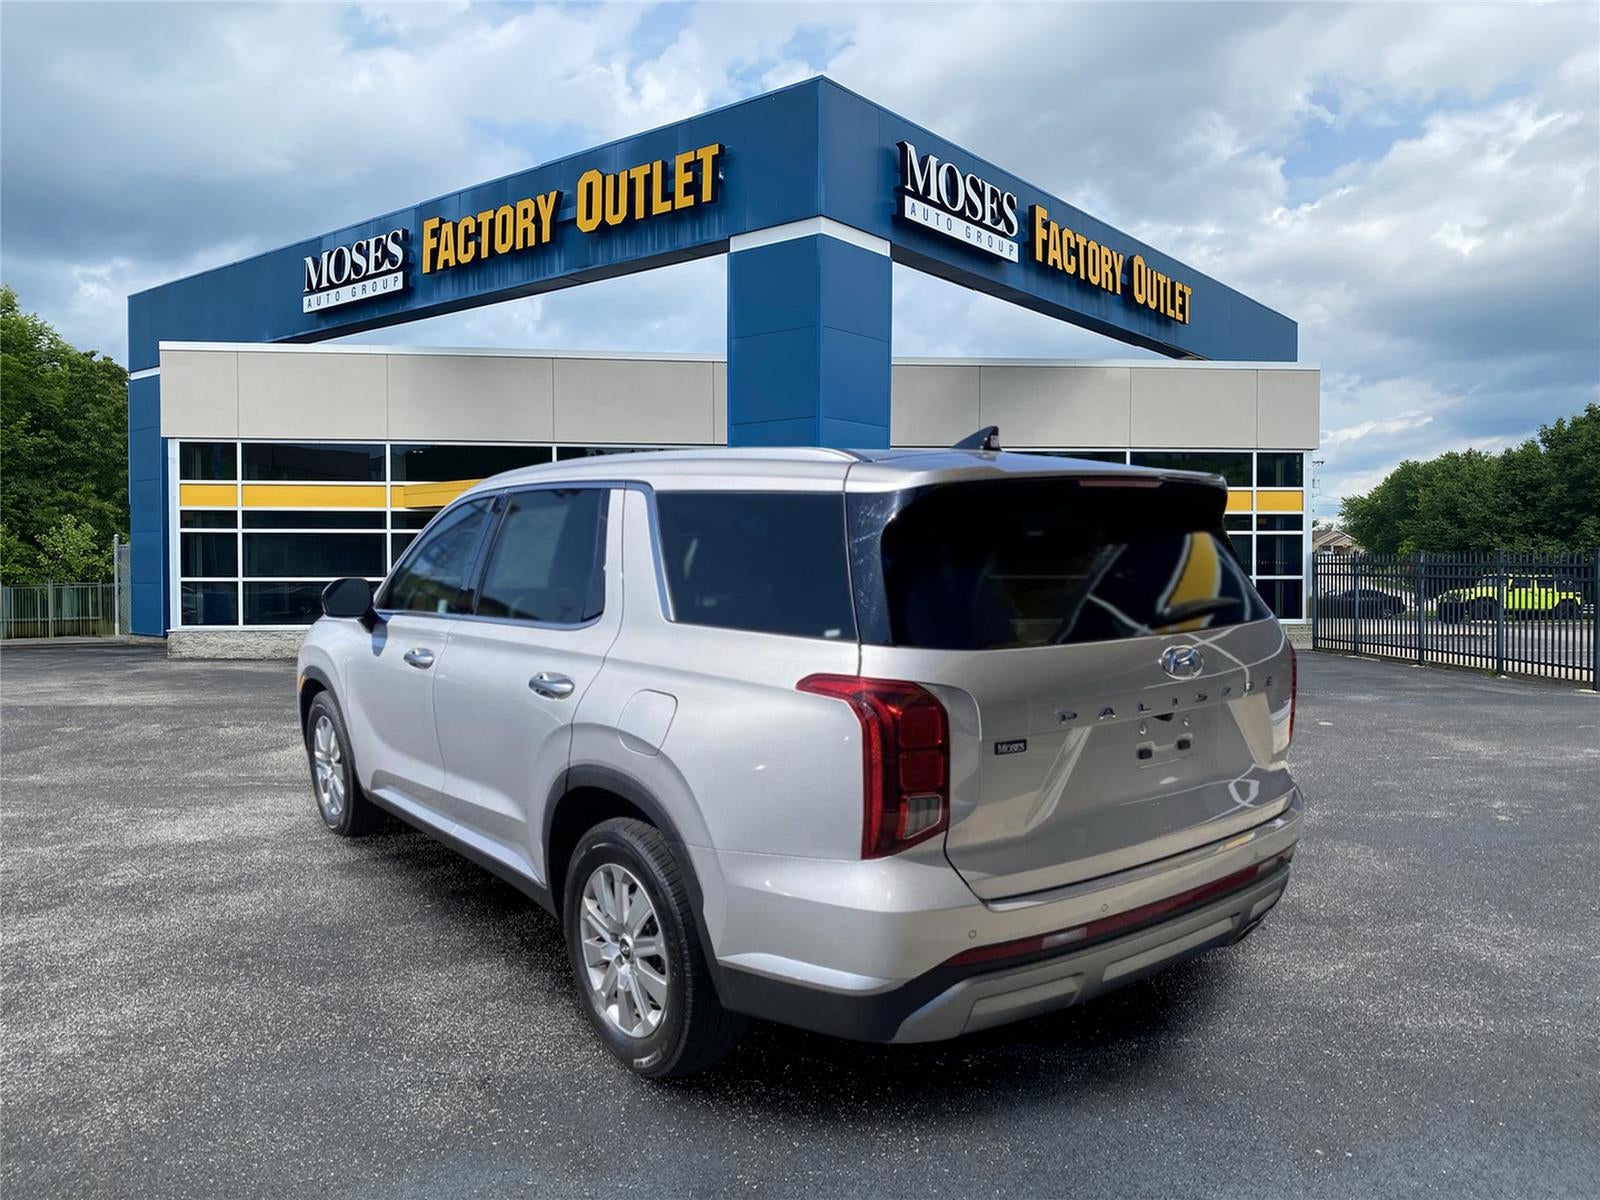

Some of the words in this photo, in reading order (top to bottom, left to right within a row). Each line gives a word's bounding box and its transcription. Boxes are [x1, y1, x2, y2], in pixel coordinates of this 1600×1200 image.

[422, 191, 558, 274] FACTORY
[576, 144, 720, 233] OUTLET
[903, 141, 1019, 237] MOSES
[910, 202, 953, 232] AUTO
[965, 225, 1015, 256] GROUP
[303, 229, 404, 293] MOSES
[307, 290, 341, 309] AUTO
[351, 275, 400, 298] GROUP
[1034, 204, 1124, 296] FACTORY
[1132, 254, 1193, 325] OUTLET
